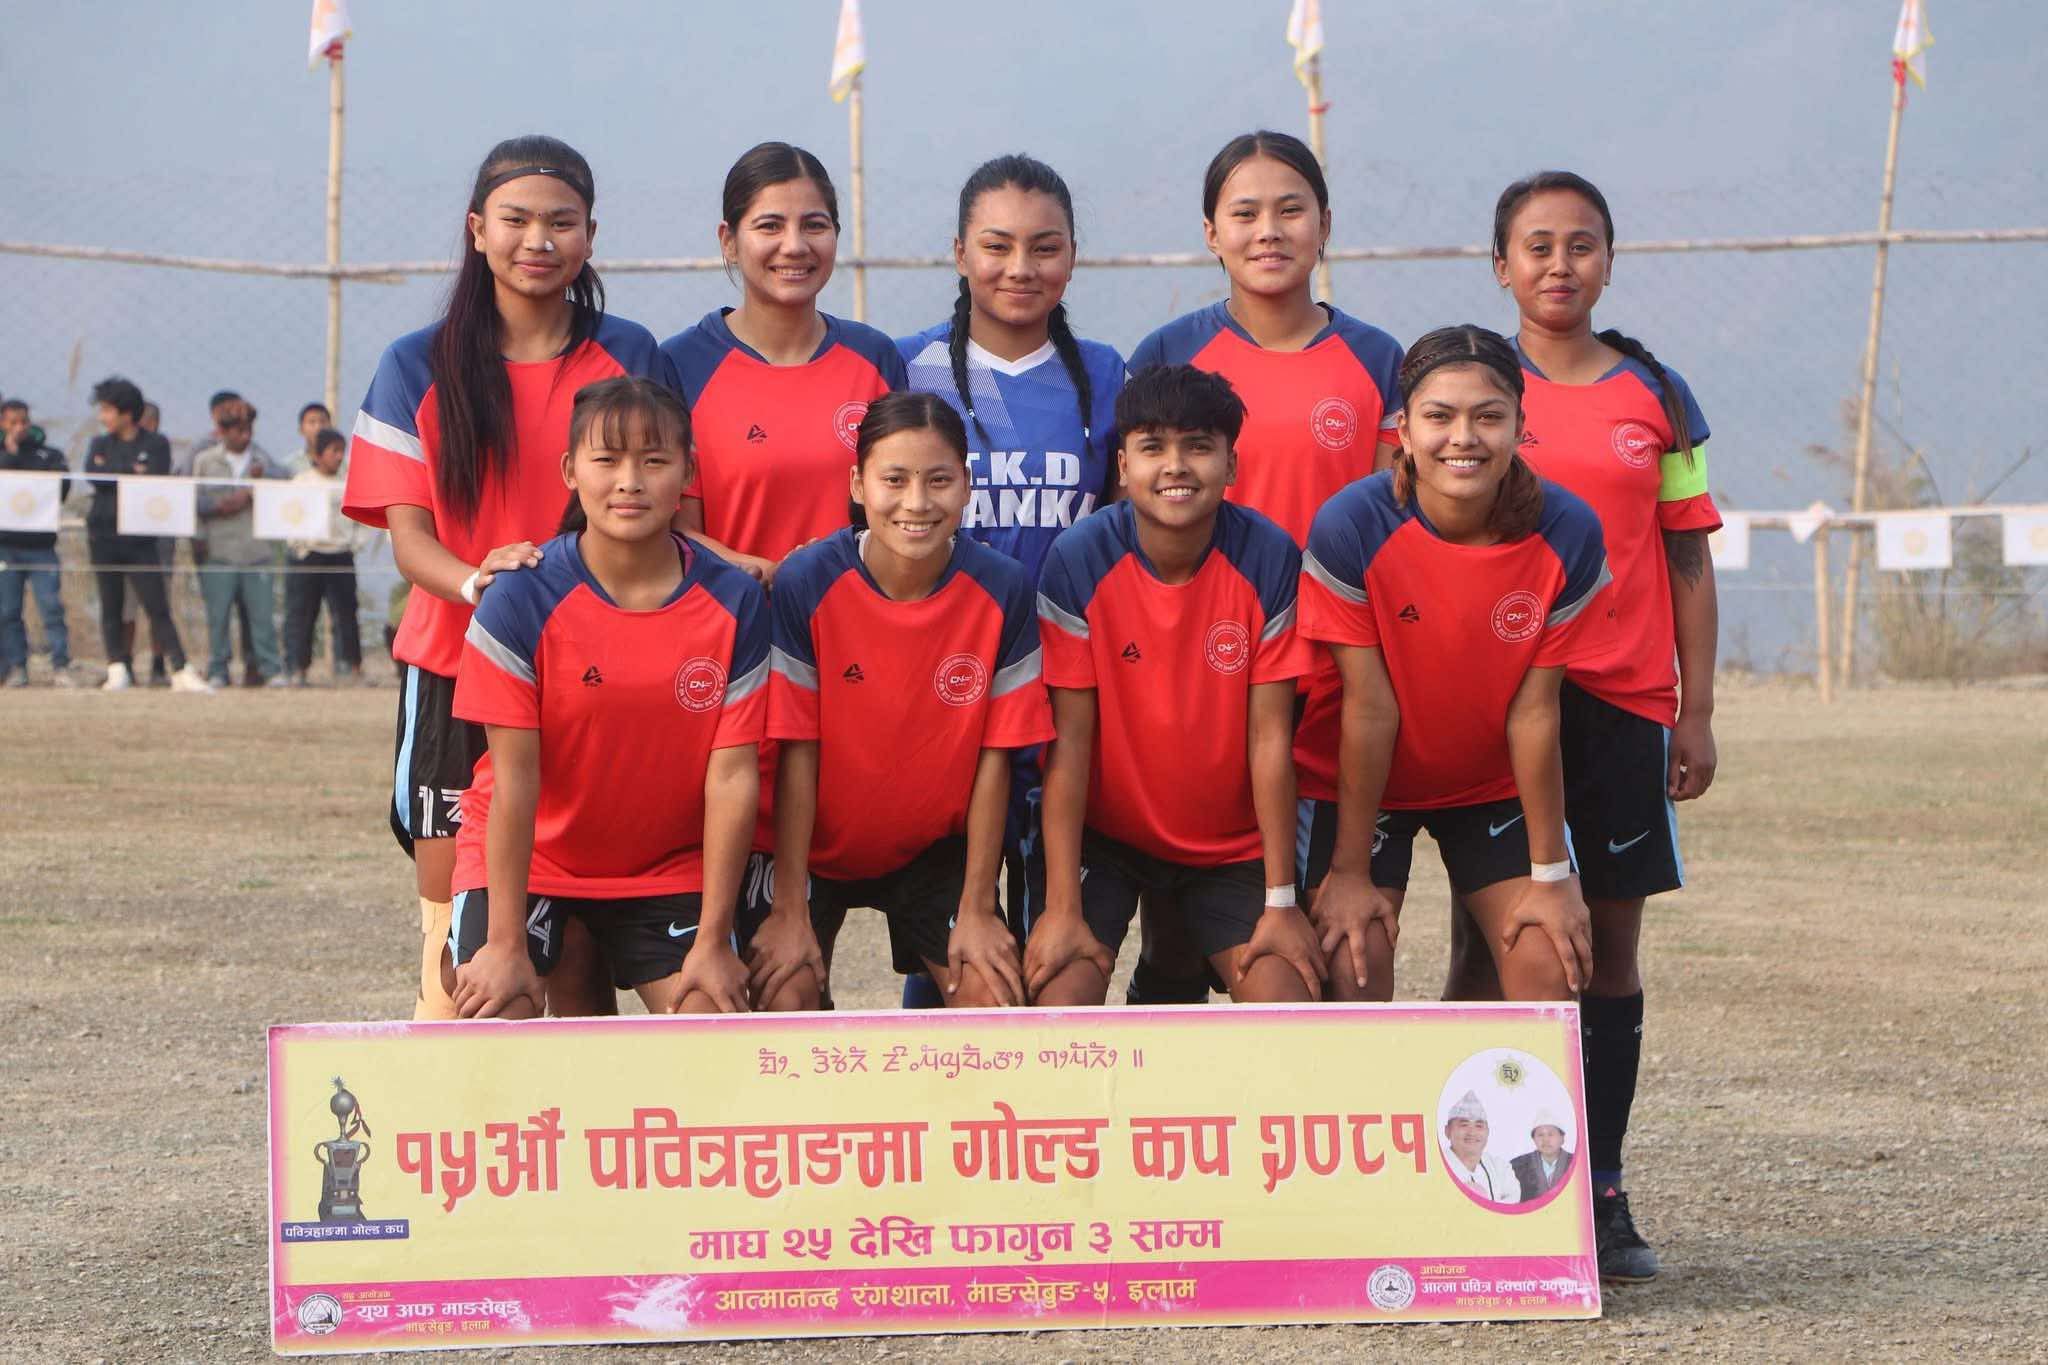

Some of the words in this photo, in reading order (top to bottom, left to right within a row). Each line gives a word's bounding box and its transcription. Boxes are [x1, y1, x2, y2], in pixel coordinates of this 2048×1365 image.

[584, 1107, 929, 1198] पवित्रहाङमा
[951, 1101, 1110, 1184] गोल्ड
[1130, 1116, 1237, 1181] कप
[1260, 1113, 1427, 1194] २०८१
[384, 1224, 404, 1234] कप
[689, 1230, 770, 1260] माघ
[783, 1228, 832, 1260] २५
[849, 1215, 935, 1259] देखि
[949, 1222, 1075, 1262] फागुन
[1089, 1222, 1113, 1253] ३
[1129, 1220, 1224, 1252] सम्म
[395, 1304, 434, 1317] अफ
[715, 1287, 840, 1311] आत्मानन्द
[1127, 1279, 1197, 1302] इलाम
